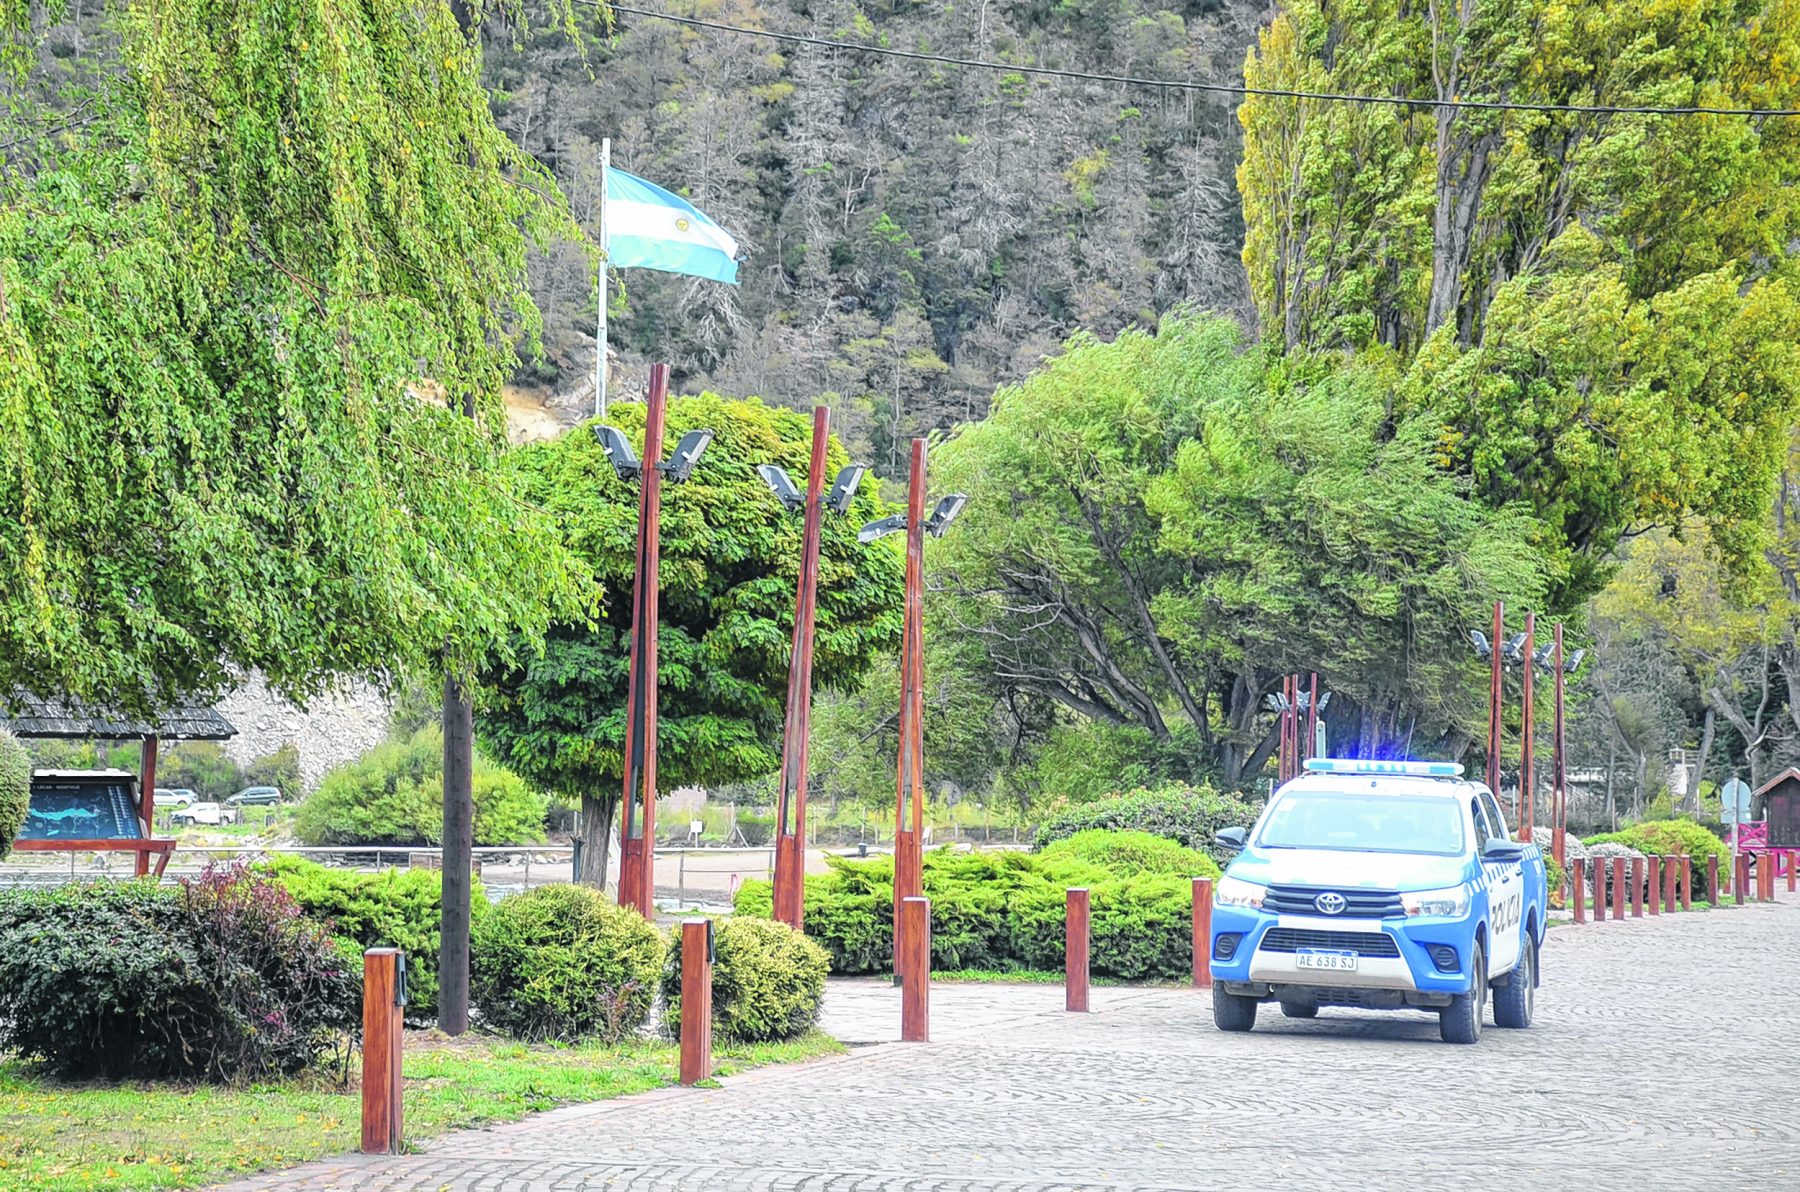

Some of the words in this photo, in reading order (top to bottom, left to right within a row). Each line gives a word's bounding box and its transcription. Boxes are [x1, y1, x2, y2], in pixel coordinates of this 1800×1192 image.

[1299, 955, 1313, 967] AE
[1316, 956, 1337, 968] 638
[1340, 957, 1354, 969] SJ
